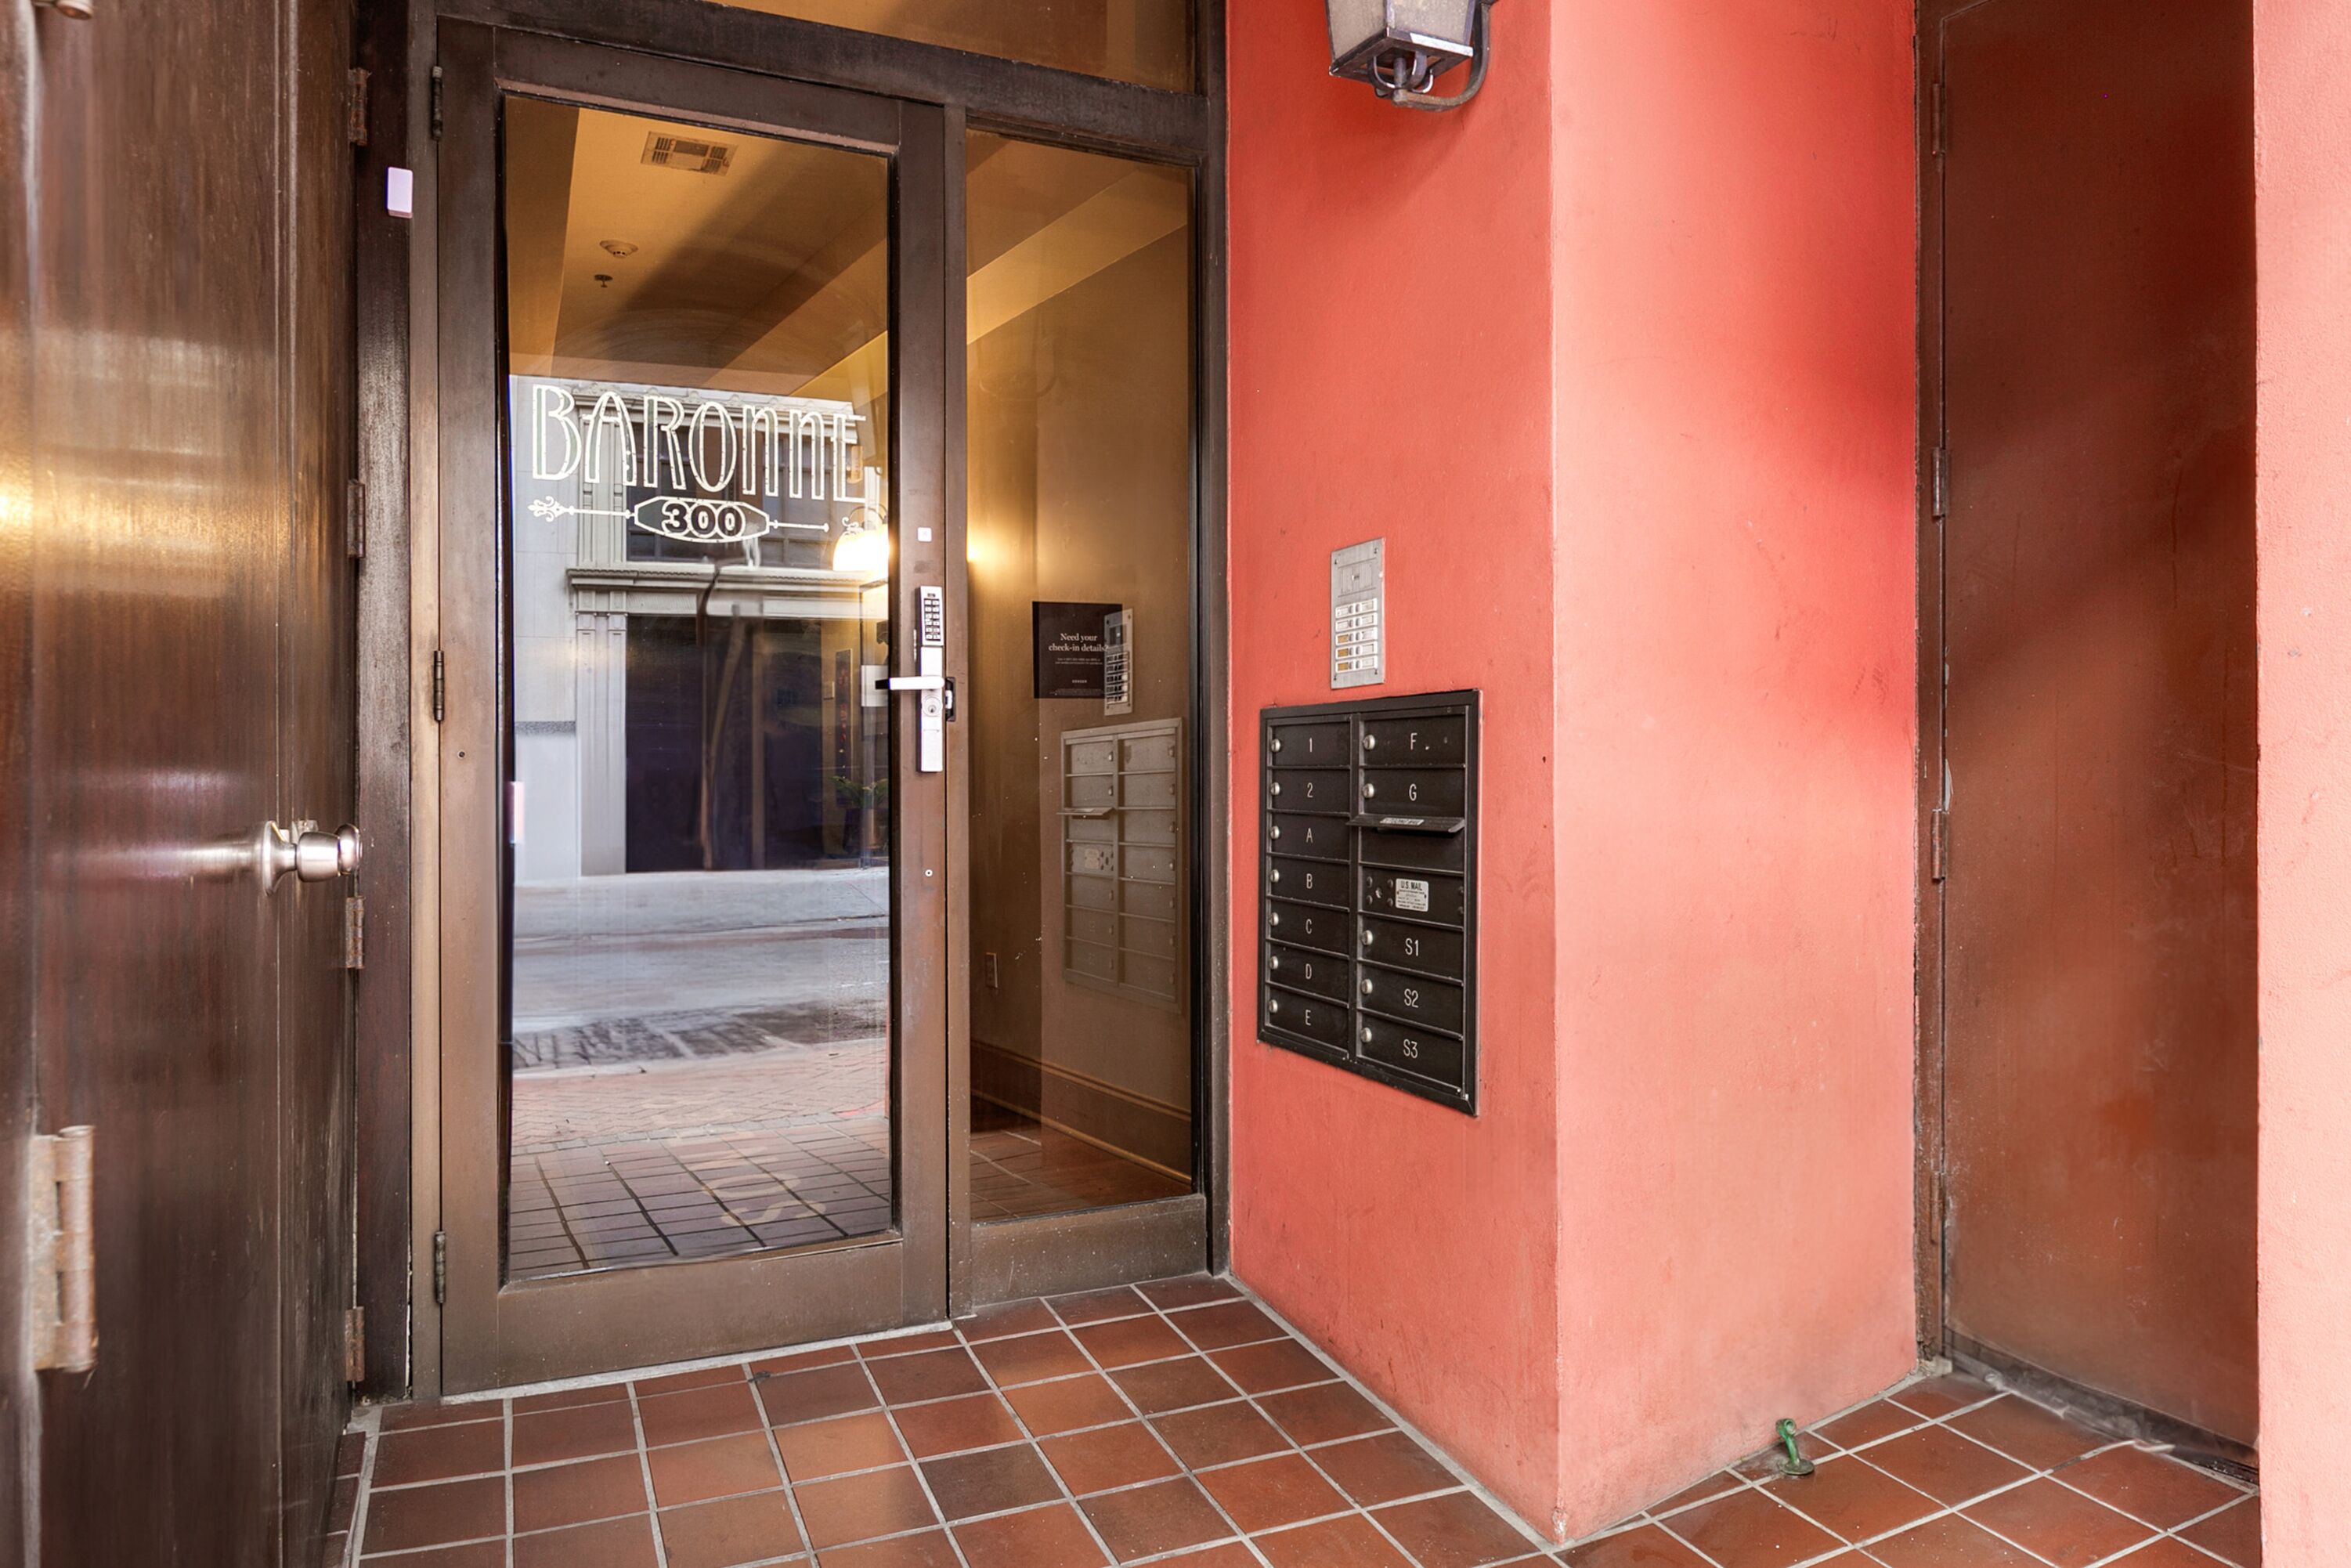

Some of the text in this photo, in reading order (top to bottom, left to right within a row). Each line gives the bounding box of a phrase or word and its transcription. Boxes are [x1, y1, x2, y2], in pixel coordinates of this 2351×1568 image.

[662, 498, 746, 538] 300
[1081, 643, 1109, 652] details?
[1309, 738, 1313, 752] 1
[1410, 733, 1417, 750] F
[1307, 782, 1313, 797] 2
[1409, 784, 1417, 800] G
[1306, 828, 1313, 843] A
[1306, 873, 1313, 889] B
[1410, 882, 1422, 891] MAIL
[1306, 919, 1312, 934] C
[1405, 938, 1419, 956] S1
[1306, 963, 1312, 979] D
[1404, 988, 1419, 1008] S2
[1305, 1010, 1311, 1025] E
[1403, 1039, 1418, 1058] S3
